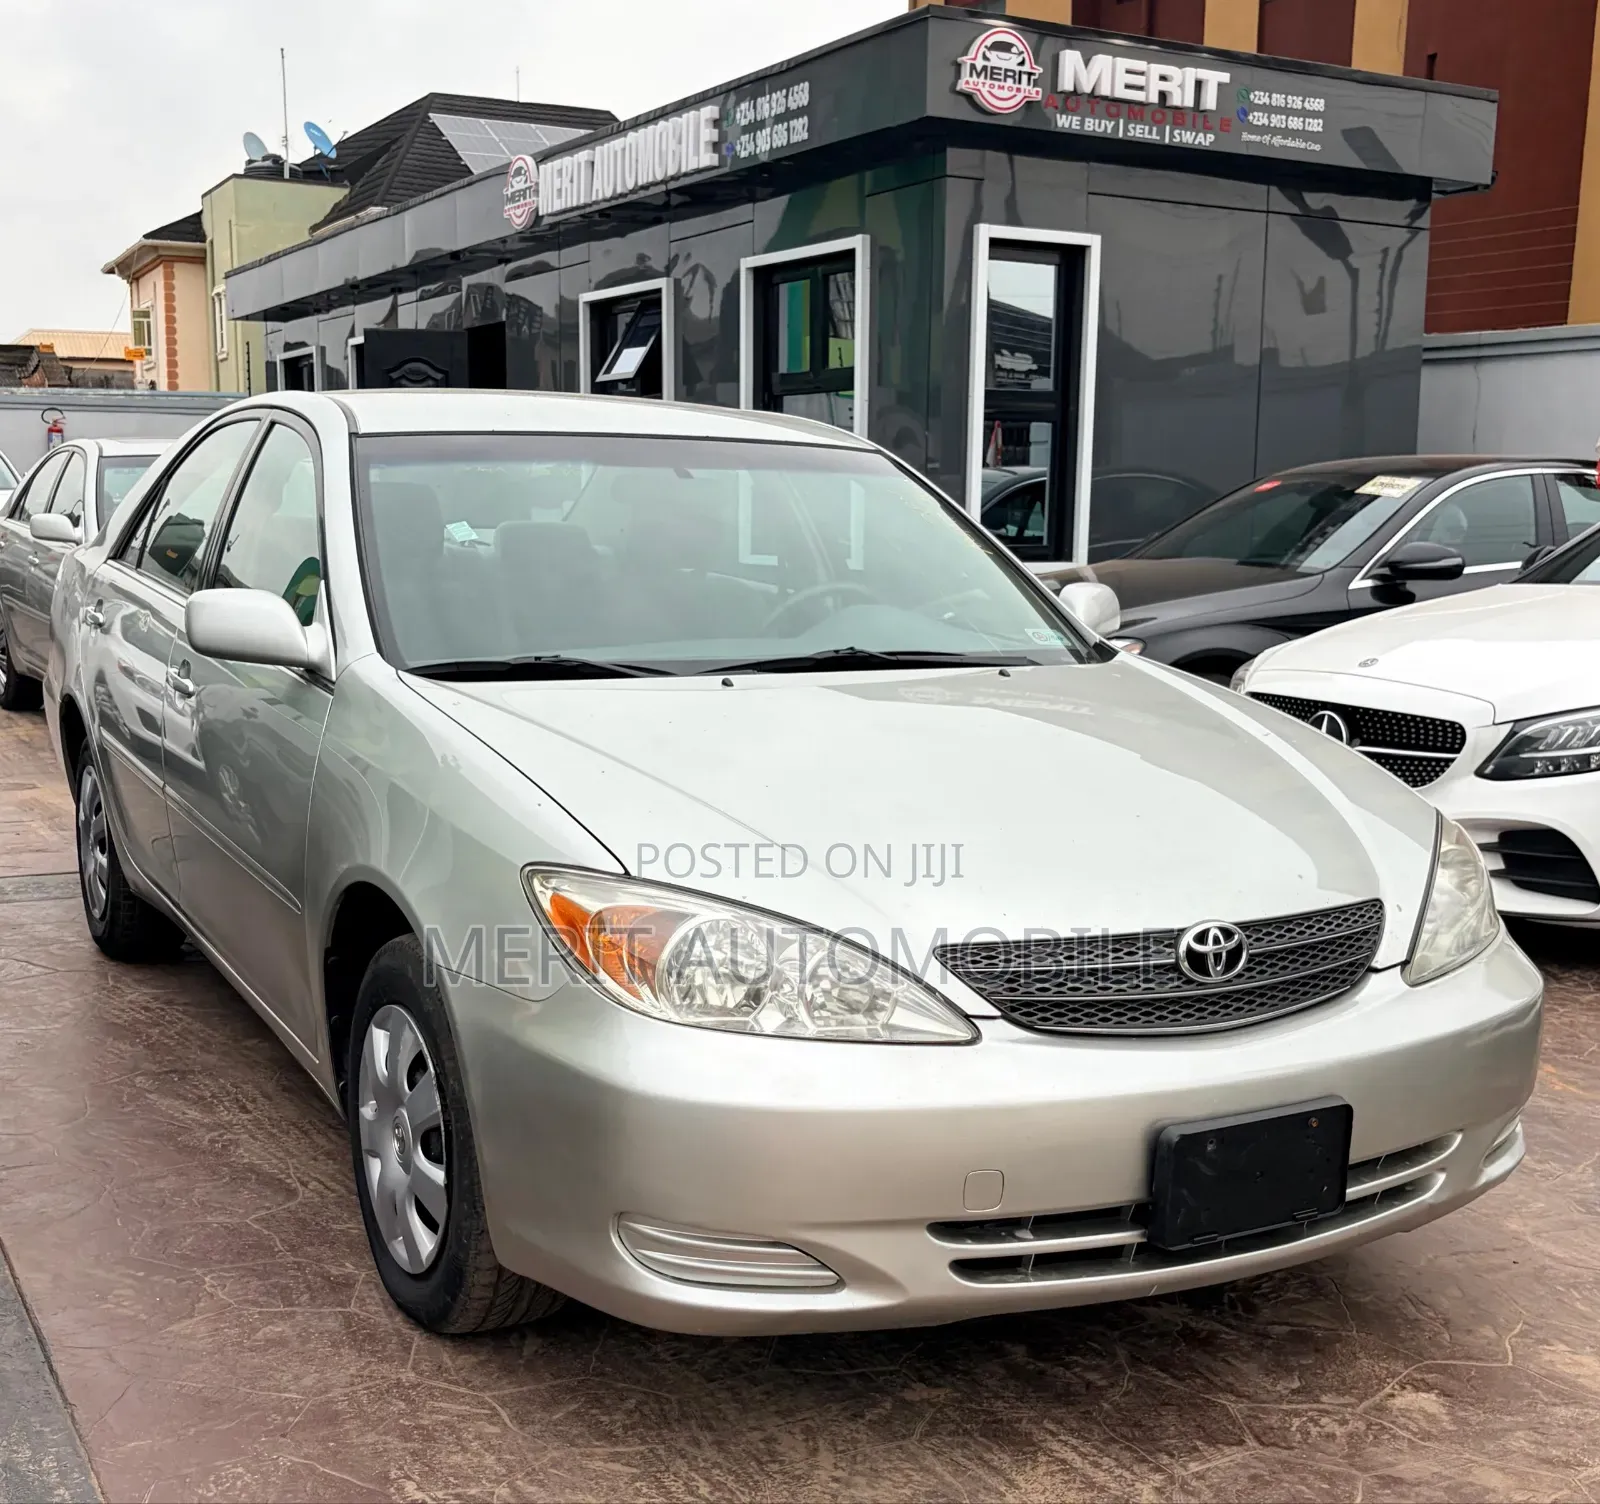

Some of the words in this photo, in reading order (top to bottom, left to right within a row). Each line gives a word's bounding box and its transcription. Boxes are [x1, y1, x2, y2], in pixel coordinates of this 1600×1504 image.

[964, 79, 1040, 96] AUTOMOBILE
[969, 63, 1036, 86] MERIT
[1057, 49, 1231, 111] MERIT
[1044, 94, 1232, 133] AUTOMOBILE
[1249, 91, 1270, 105] +234
[1271, 93, 1285, 107] 816
[1287, 95, 1303, 110] 926
[1056, 113, 1081, 130] WE
[1084, 117, 1116, 134] BUY
[1127, 123, 1160, 140] SELL
[1172, 129, 1215, 147] SWAP
[1248, 112, 1269, 126] +234
[1270, 114, 1286, 128] 903
[1305, 118, 1323, 132] 1282
[539, 150, 594, 216] MERIT
[591, 105, 720, 201] AUTOMOBILE
